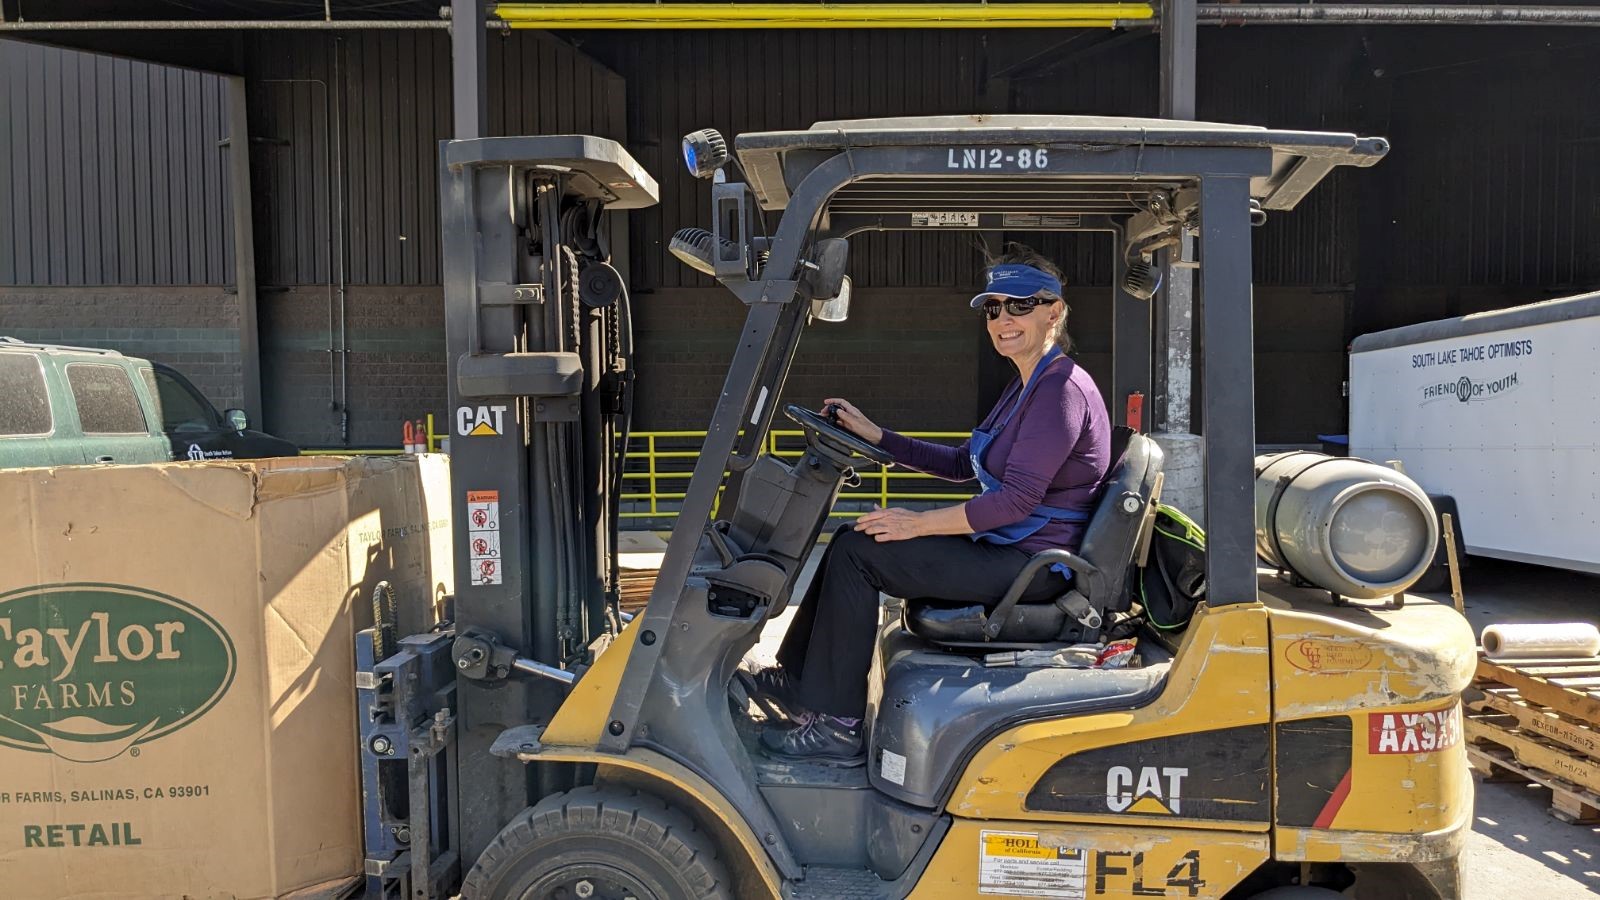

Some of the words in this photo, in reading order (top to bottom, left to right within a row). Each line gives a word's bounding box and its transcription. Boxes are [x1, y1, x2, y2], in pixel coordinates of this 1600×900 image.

[947, 148, 1049, 169] LN12-86
[1412, 353, 1436, 368] SOUTH
[1437, 350, 1457, 365] LAKE
[1459, 346, 1485, 362] TAHOE
[1488, 339, 1533, 359] OPTIMISTS
[1423, 382, 1456, 399] FRIEND
[1472, 384, 1484, 396] OF
[1486, 371, 1518, 395] YOUTH
[456, 405, 507, 436] CAT
[12, 680, 136, 710] FARMS
[15, 791, 67, 804] FARMS,
[70, 789, 139, 802] SALINAS,
[143, 787, 164, 799] CA
[169, 785, 210, 798] 93901
[1106, 766, 1188, 815] CAT
[24, 822, 142, 848] RETAIL
[1095, 849, 1206, 897] FL4
